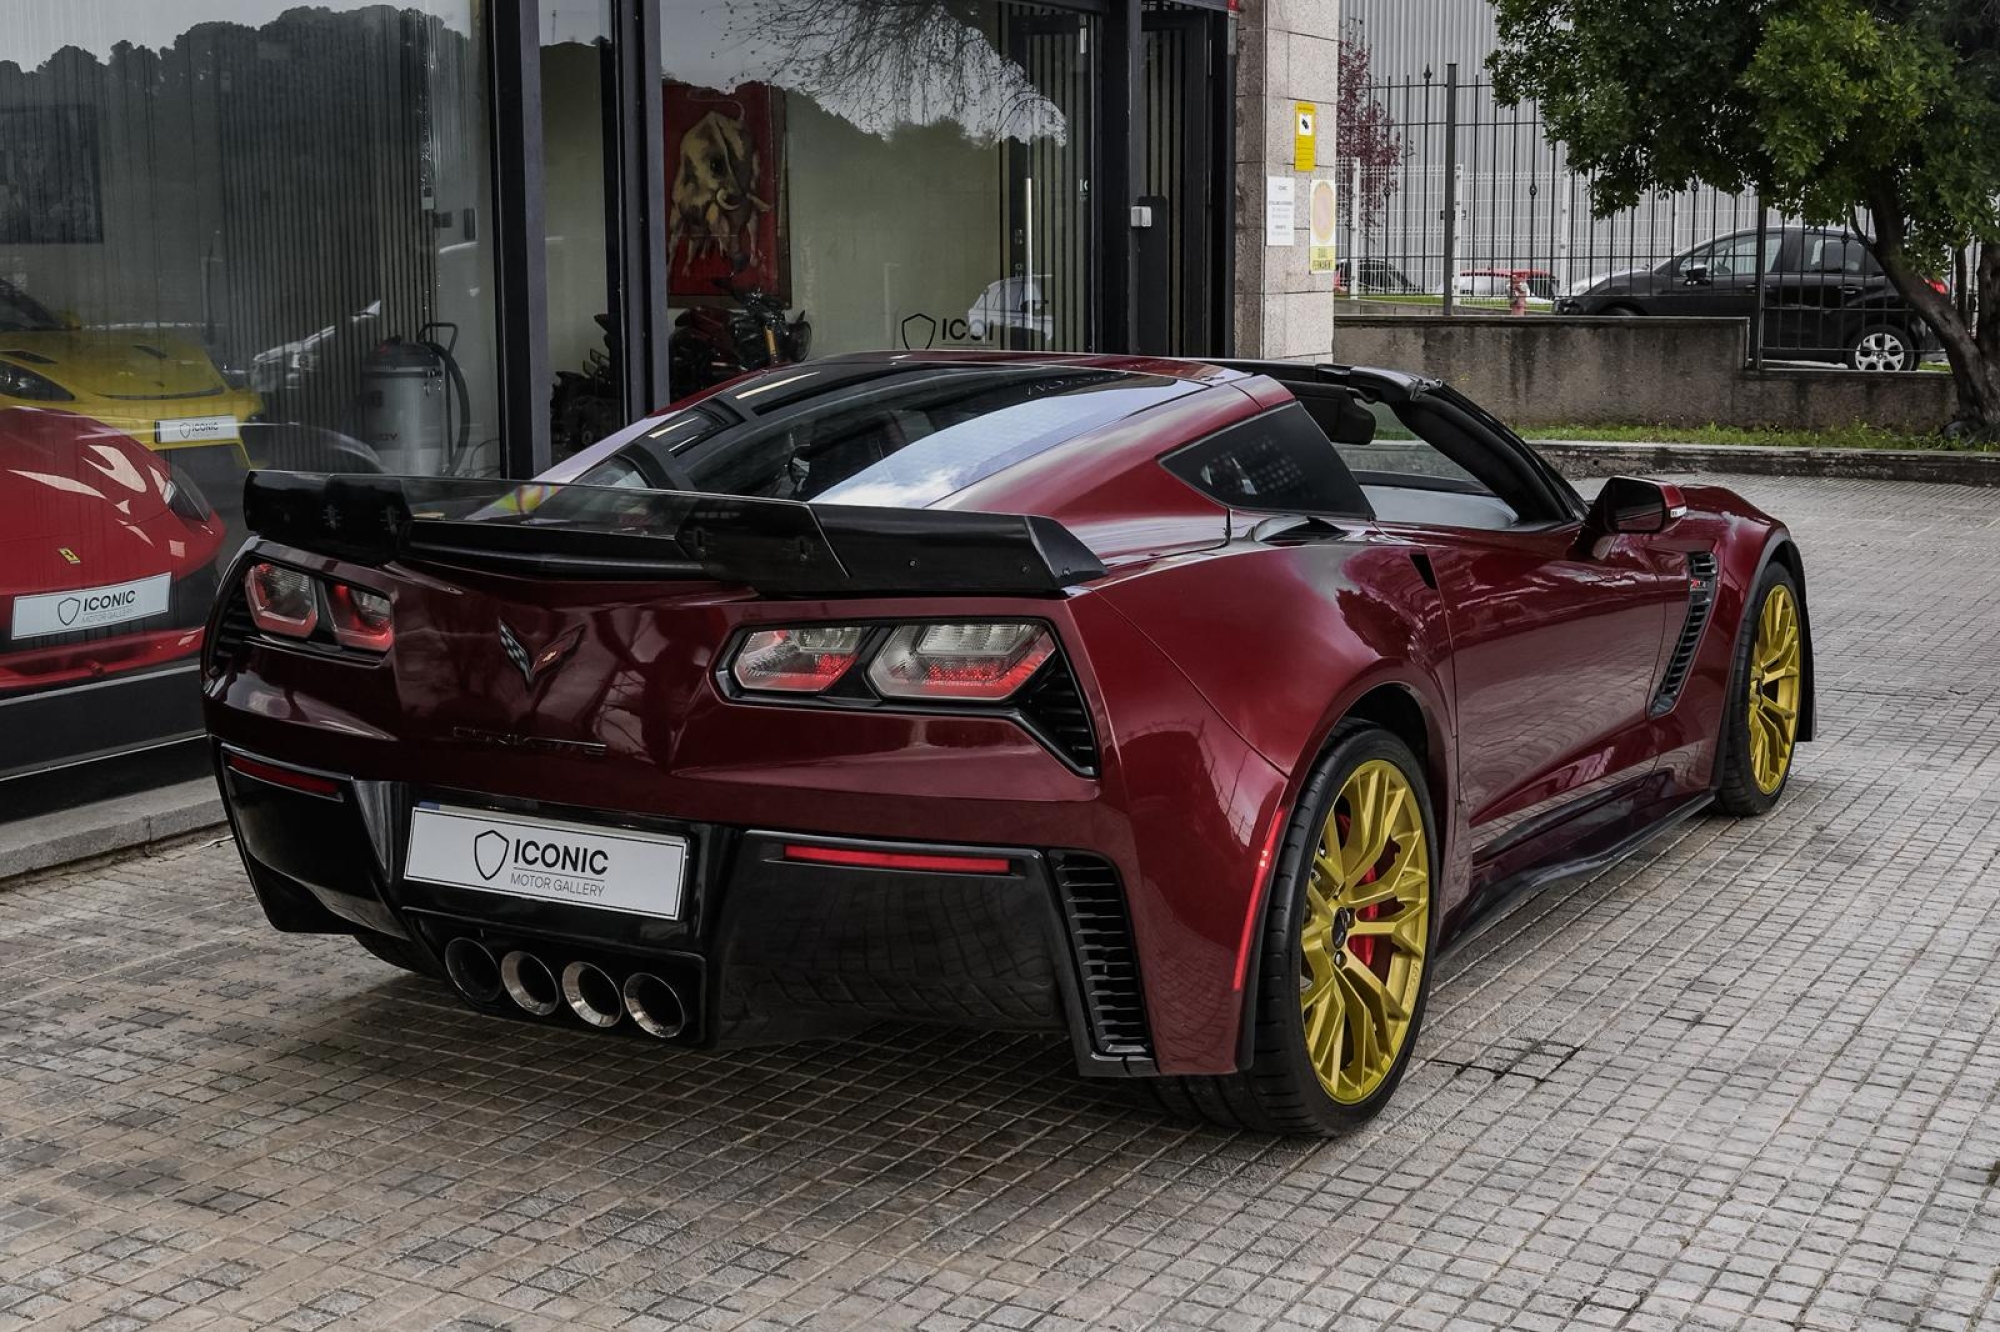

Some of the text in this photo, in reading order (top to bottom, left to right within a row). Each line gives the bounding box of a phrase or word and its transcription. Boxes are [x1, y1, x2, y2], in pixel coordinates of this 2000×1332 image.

[84, 590, 136, 611] ICONIC
[513, 838, 608, 875] ICONIC
[511, 873, 605, 896] MOTOR GALLERY
